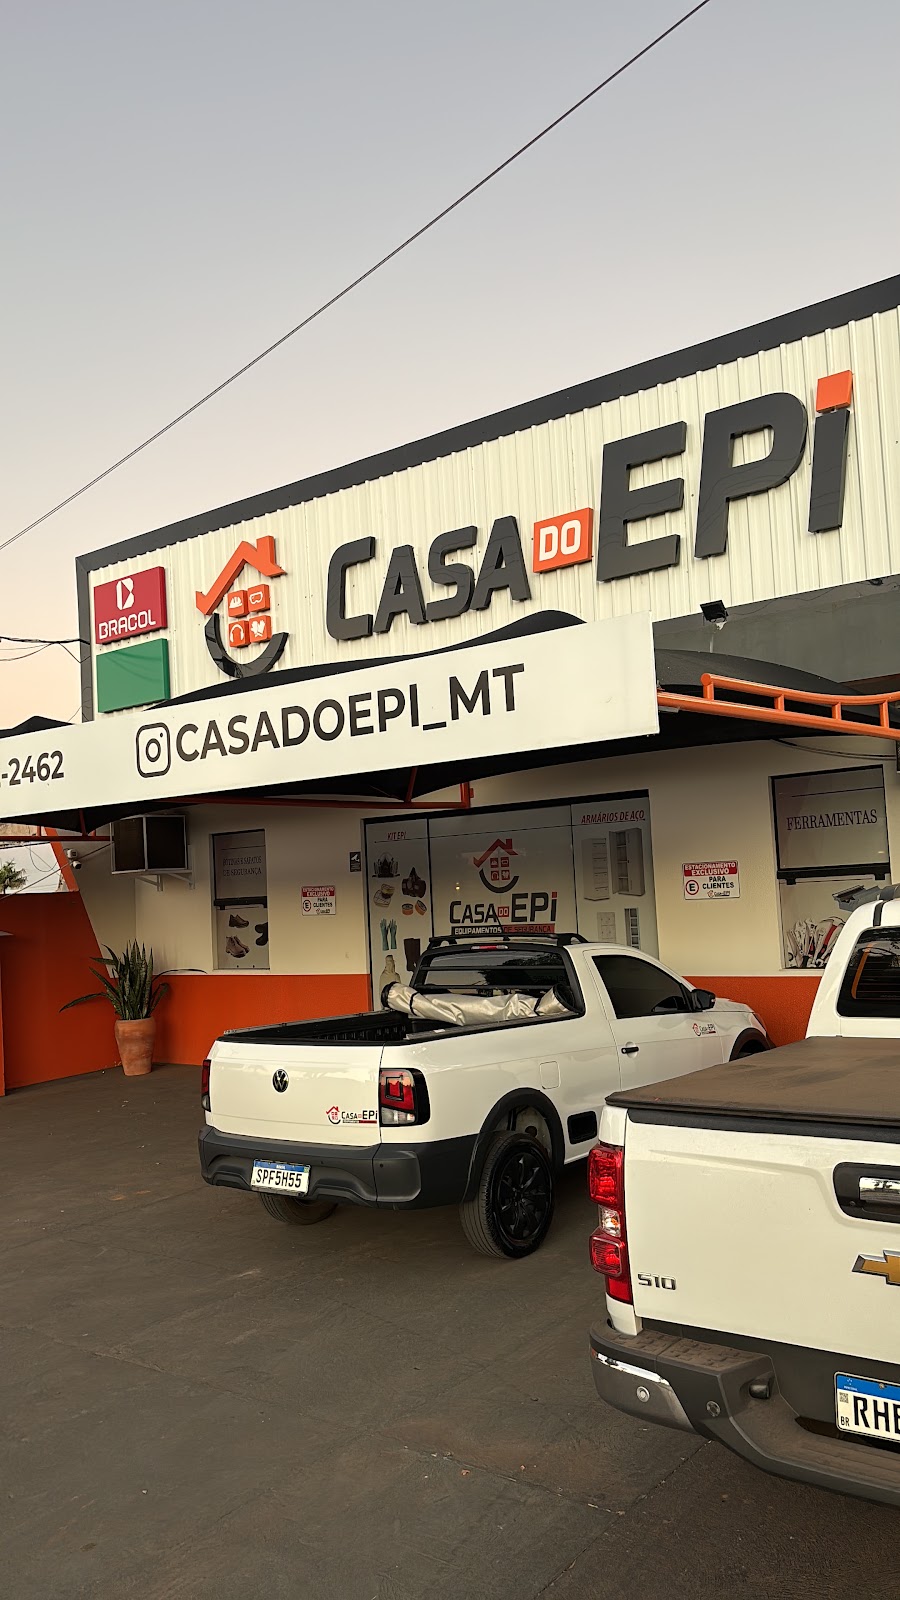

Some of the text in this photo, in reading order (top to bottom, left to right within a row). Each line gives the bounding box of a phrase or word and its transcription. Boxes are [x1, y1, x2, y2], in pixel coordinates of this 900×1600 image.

[326, 515, 532, 641] CASA
[538, 518, 582, 563] DO
[98, 608, 157, 640] BRACOL
[175, 663, 525, 762] CASADOEPI_MT
[0, 750, 65, 788] -2462
[580, 810, 645, 824] ARMÁRIOS DE AÇO
[786, 808, 878, 831] FERRAMENTAS
[231, 867, 262, 876] SEGURANÇA
[684, 862, 736, 871] ESTACIONAMENTO
[691, 868, 730, 876] EXCLUSIVO
[689, 883, 696, 892] E
[702, 882, 735, 890] CLIENTES
[449, 901, 498, 924] CASA
[454, 926, 502, 935] EQUIPAMENTOS
[255, 1168, 303, 1188] SPF5H55
[637, 1271, 677, 1291] S10
[840, 1415, 850, 1427] BR
